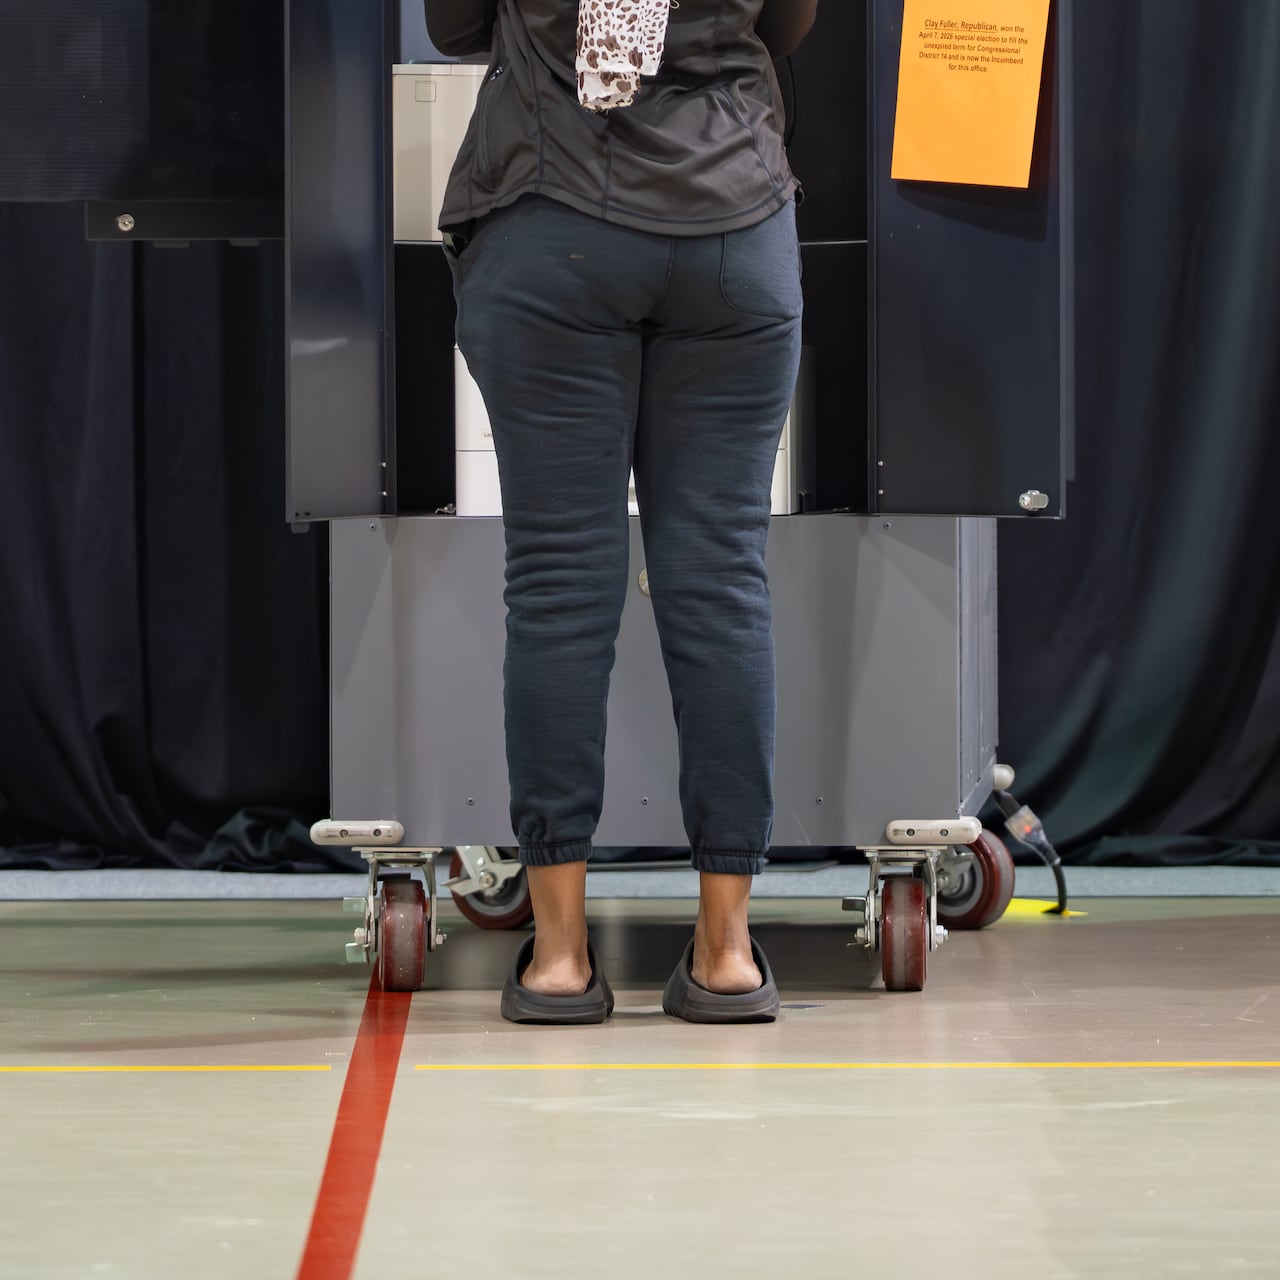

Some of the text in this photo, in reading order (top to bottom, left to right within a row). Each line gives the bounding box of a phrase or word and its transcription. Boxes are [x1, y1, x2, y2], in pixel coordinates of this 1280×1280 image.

[925, 19, 938, 28] Clay
[940, 20, 959, 29] Fuller,
[960, 21, 998, 32] Republican,
[977, 45, 1020, 54] Congressional
[919, 51, 940, 59] District
[991, 56, 1024, 64] Incumbent
